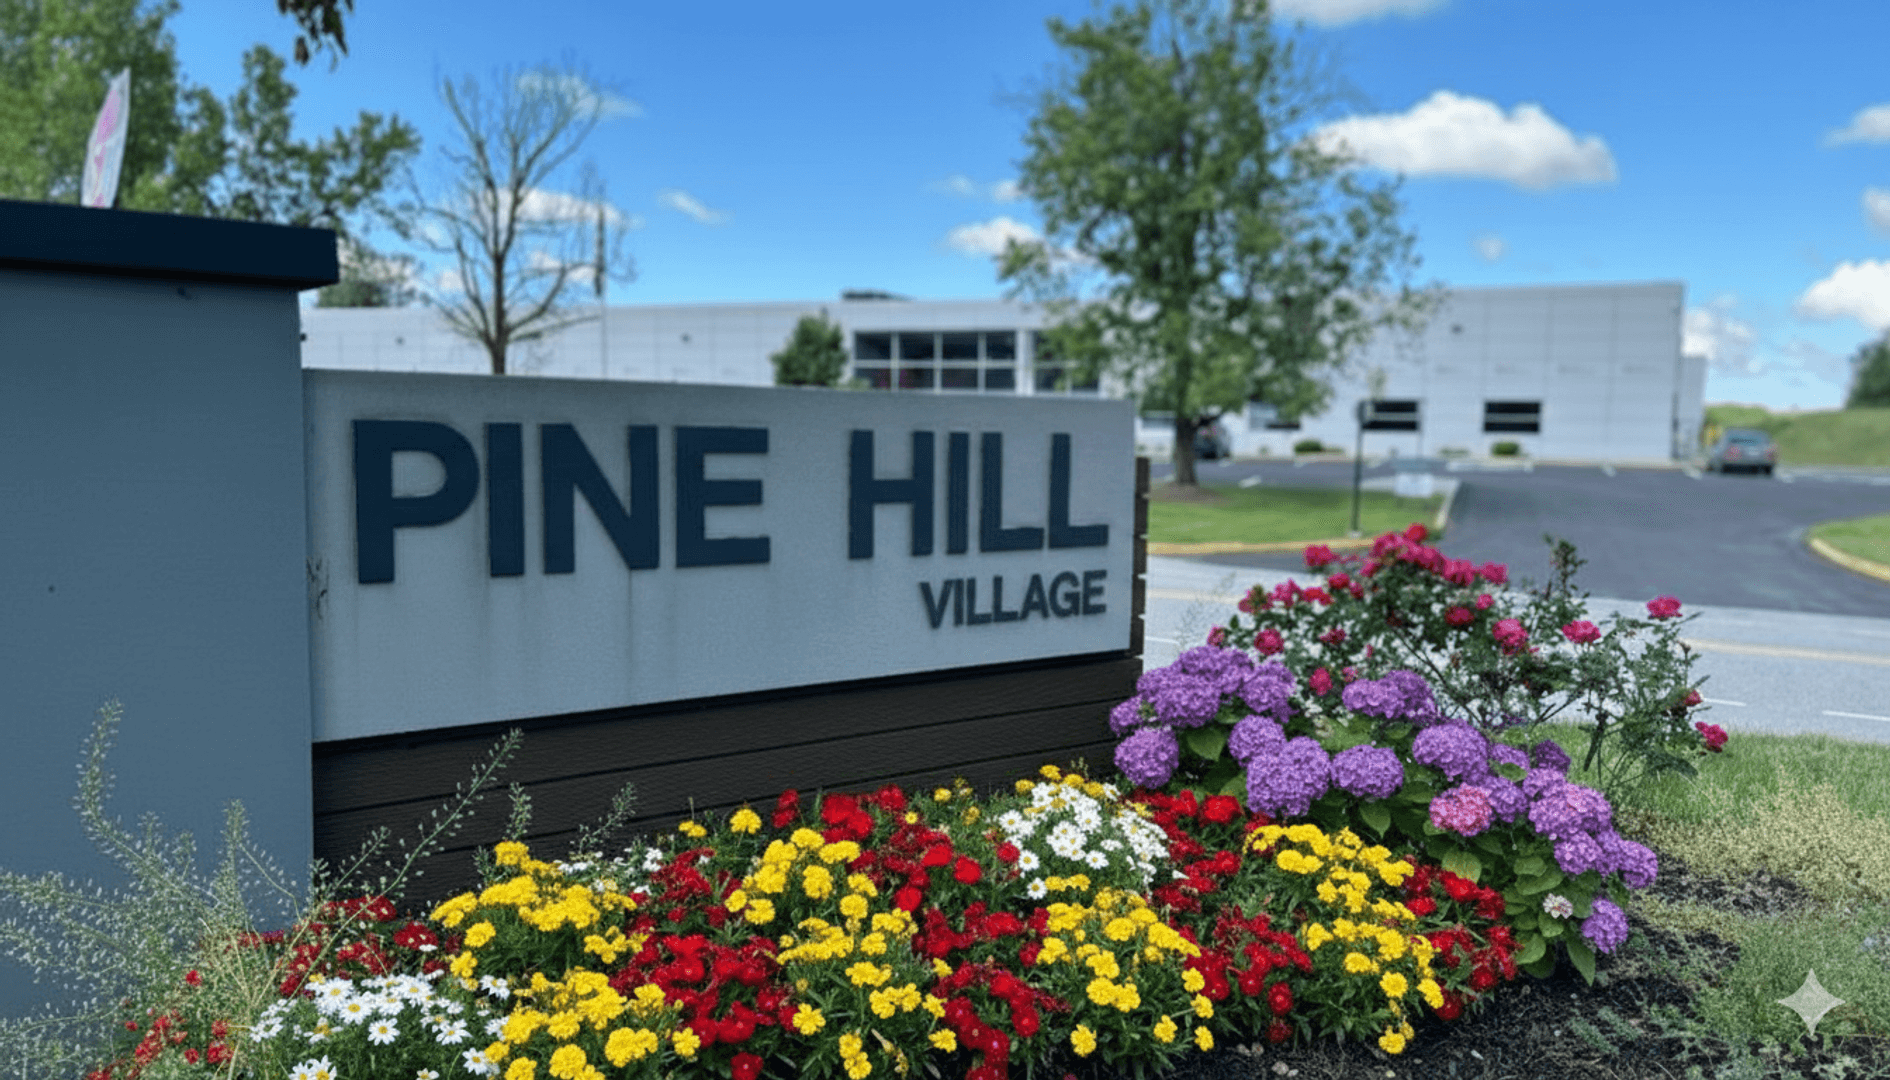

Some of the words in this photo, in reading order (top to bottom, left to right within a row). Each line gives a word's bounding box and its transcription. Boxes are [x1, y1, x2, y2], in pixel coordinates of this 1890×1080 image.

[352, 419, 771, 584] PINE
[848, 429, 1109, 560] HILL
[920, 569, 1107, 629] VILLAGE
